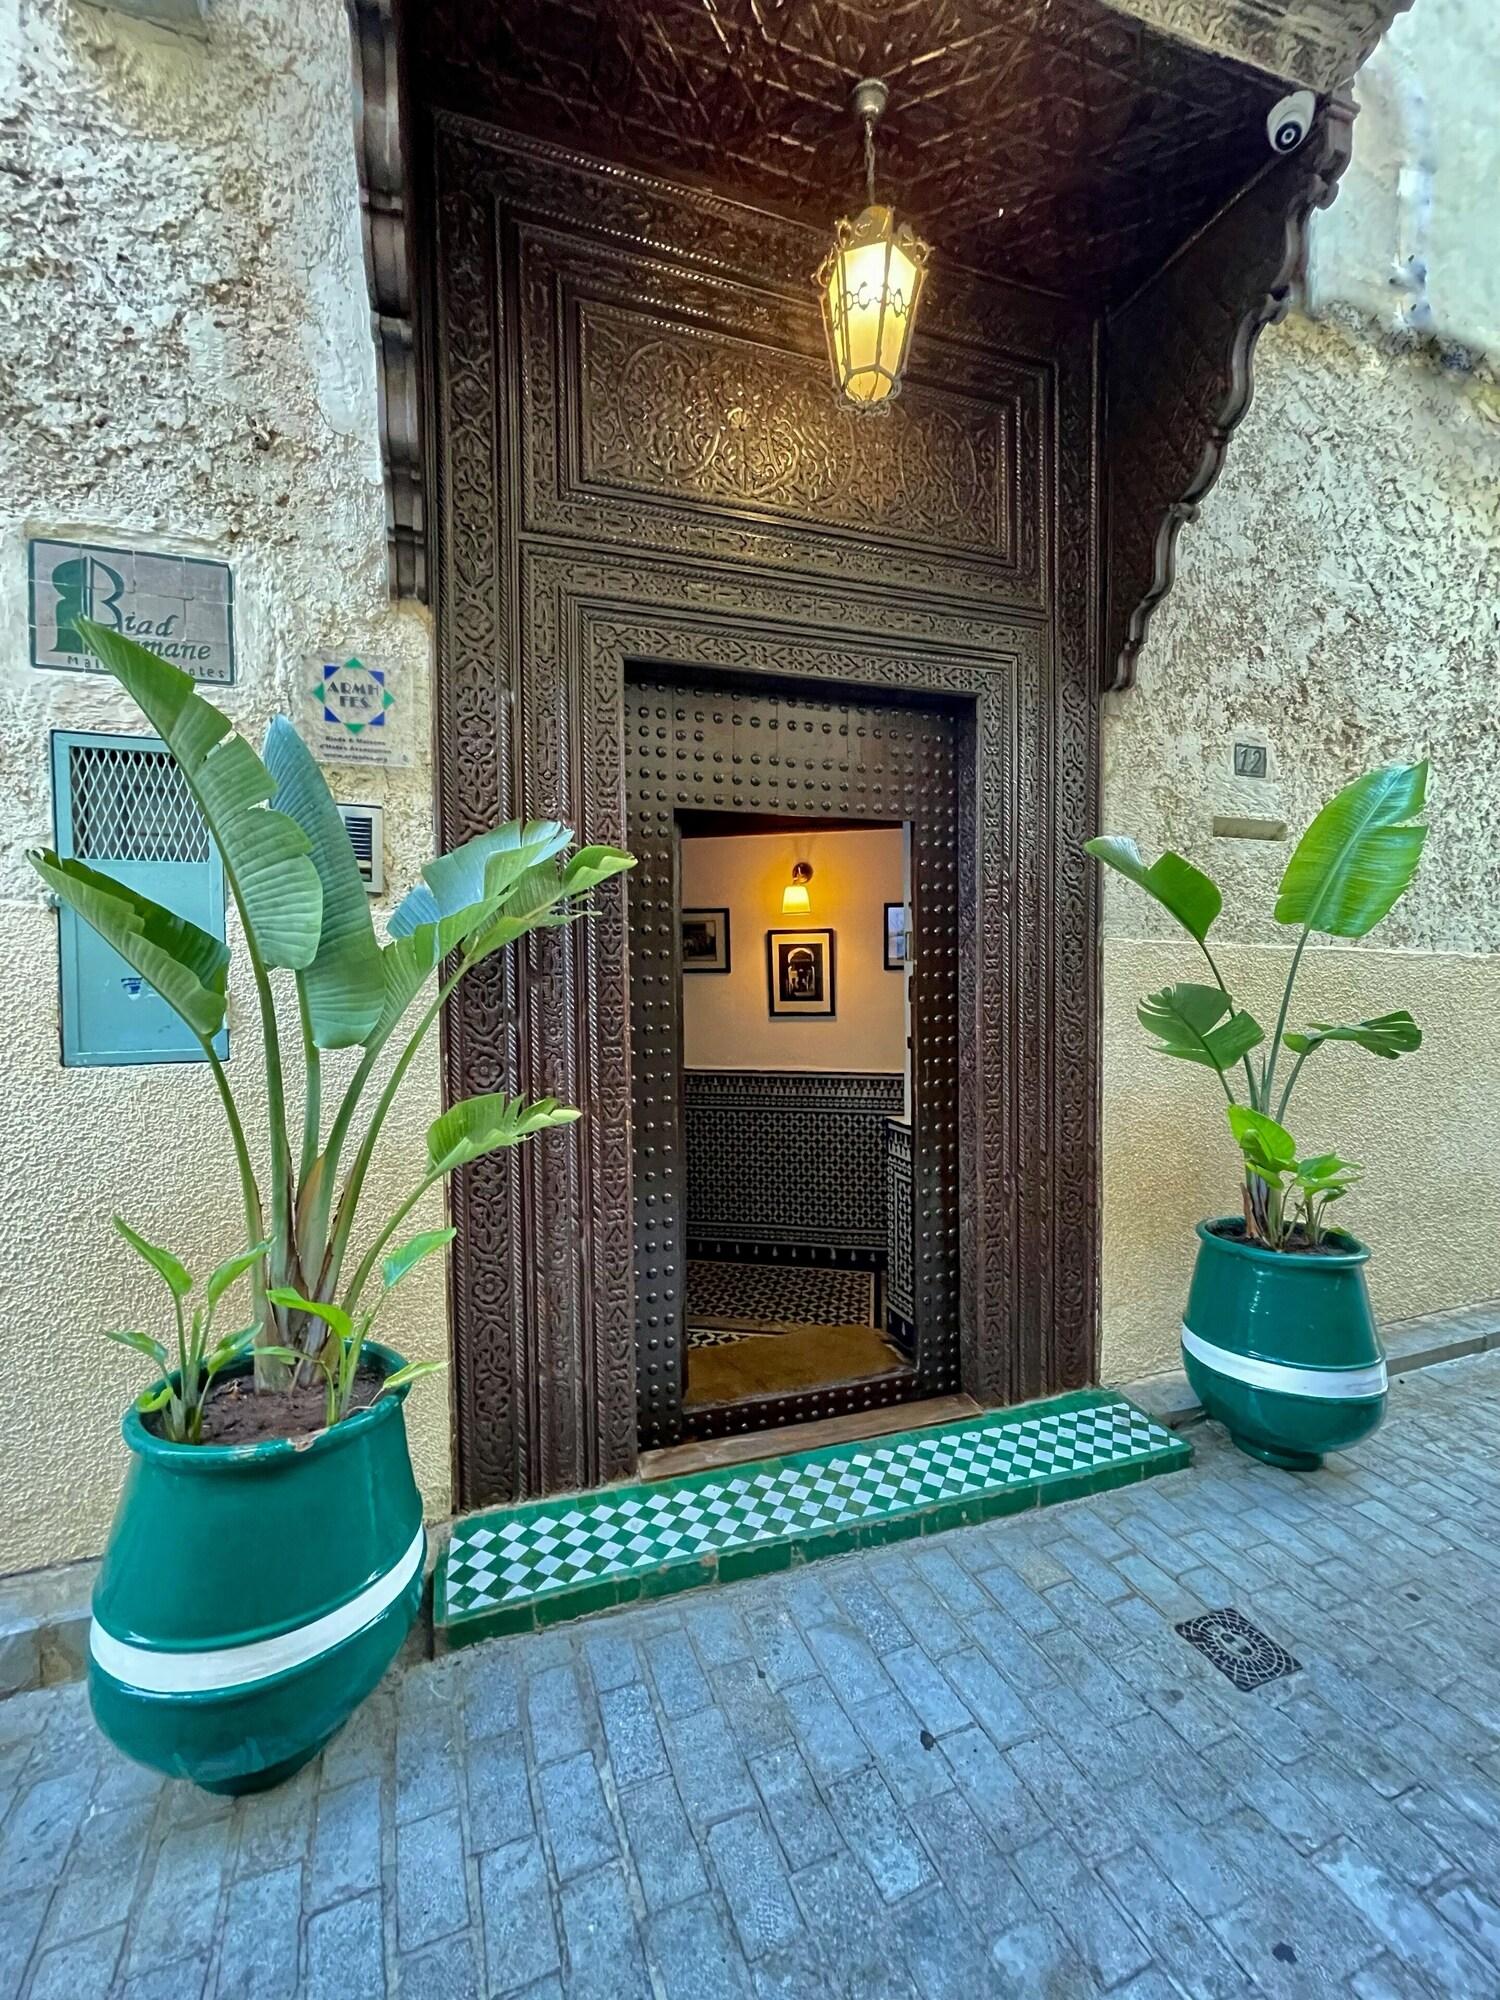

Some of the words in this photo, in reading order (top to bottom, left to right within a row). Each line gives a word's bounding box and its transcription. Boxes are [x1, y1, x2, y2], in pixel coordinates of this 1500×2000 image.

[327, 682, 378, 696] ARMH
[340, 696, 371, 708] FES
[1239, 749, 1262, 773] 12
